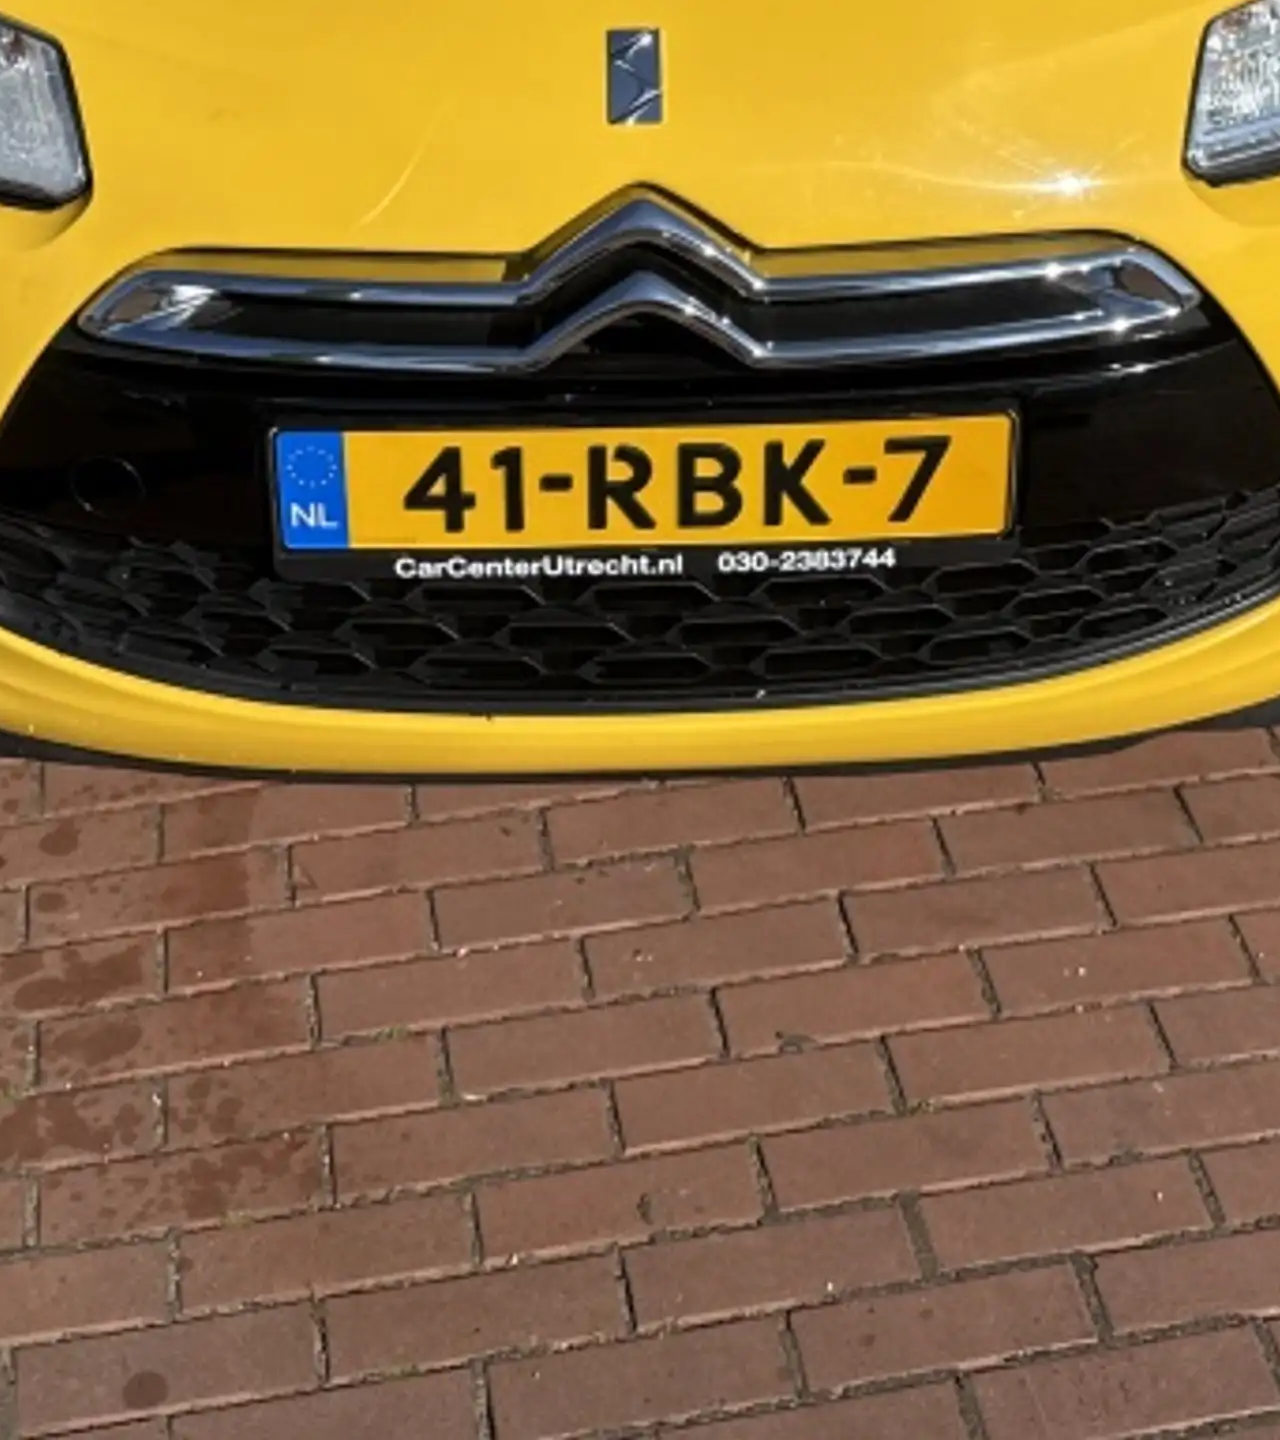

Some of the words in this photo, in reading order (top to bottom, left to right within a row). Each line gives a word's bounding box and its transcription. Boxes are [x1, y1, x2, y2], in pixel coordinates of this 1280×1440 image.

[403, 436, 951, 534] 41-RBK-7
[290, 501, 339, 529] NL
[394, 553, 684, 579] CarCenterUtrecht.nl
